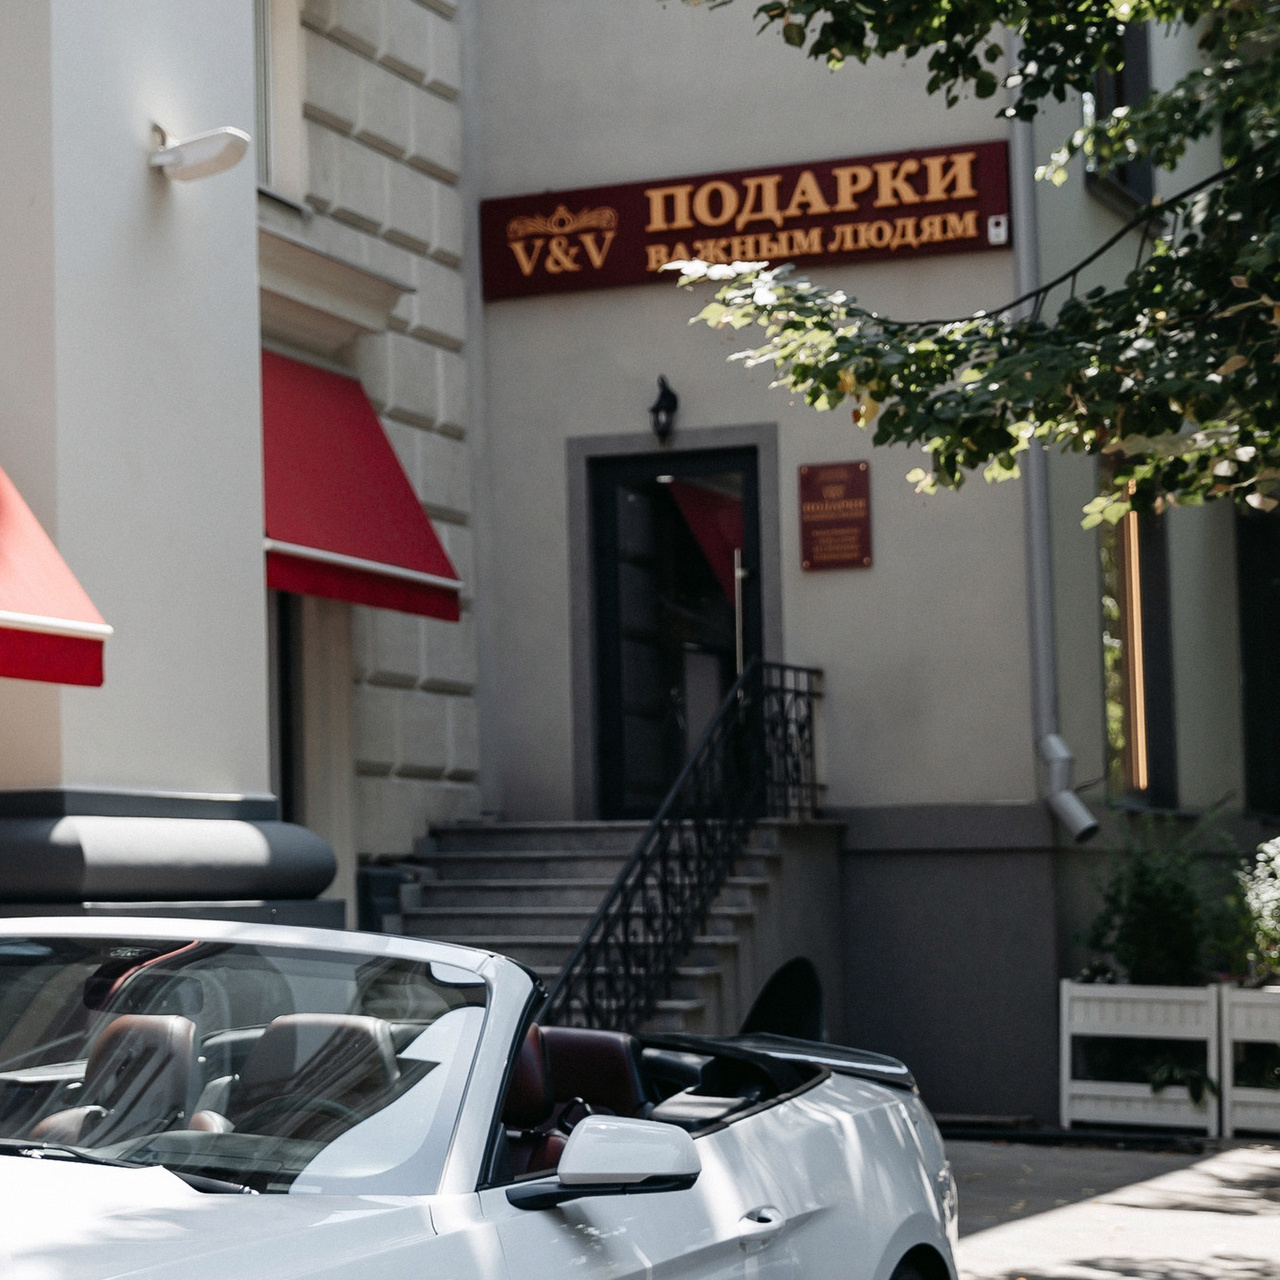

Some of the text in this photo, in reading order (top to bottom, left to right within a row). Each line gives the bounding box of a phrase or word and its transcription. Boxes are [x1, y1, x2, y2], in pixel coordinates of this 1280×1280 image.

[646, 152, 977, 233] ПОДАРКИ
[509, 231, 614, 276] V&V
[828, 210, 978, 254] ЛЮДЯМ
